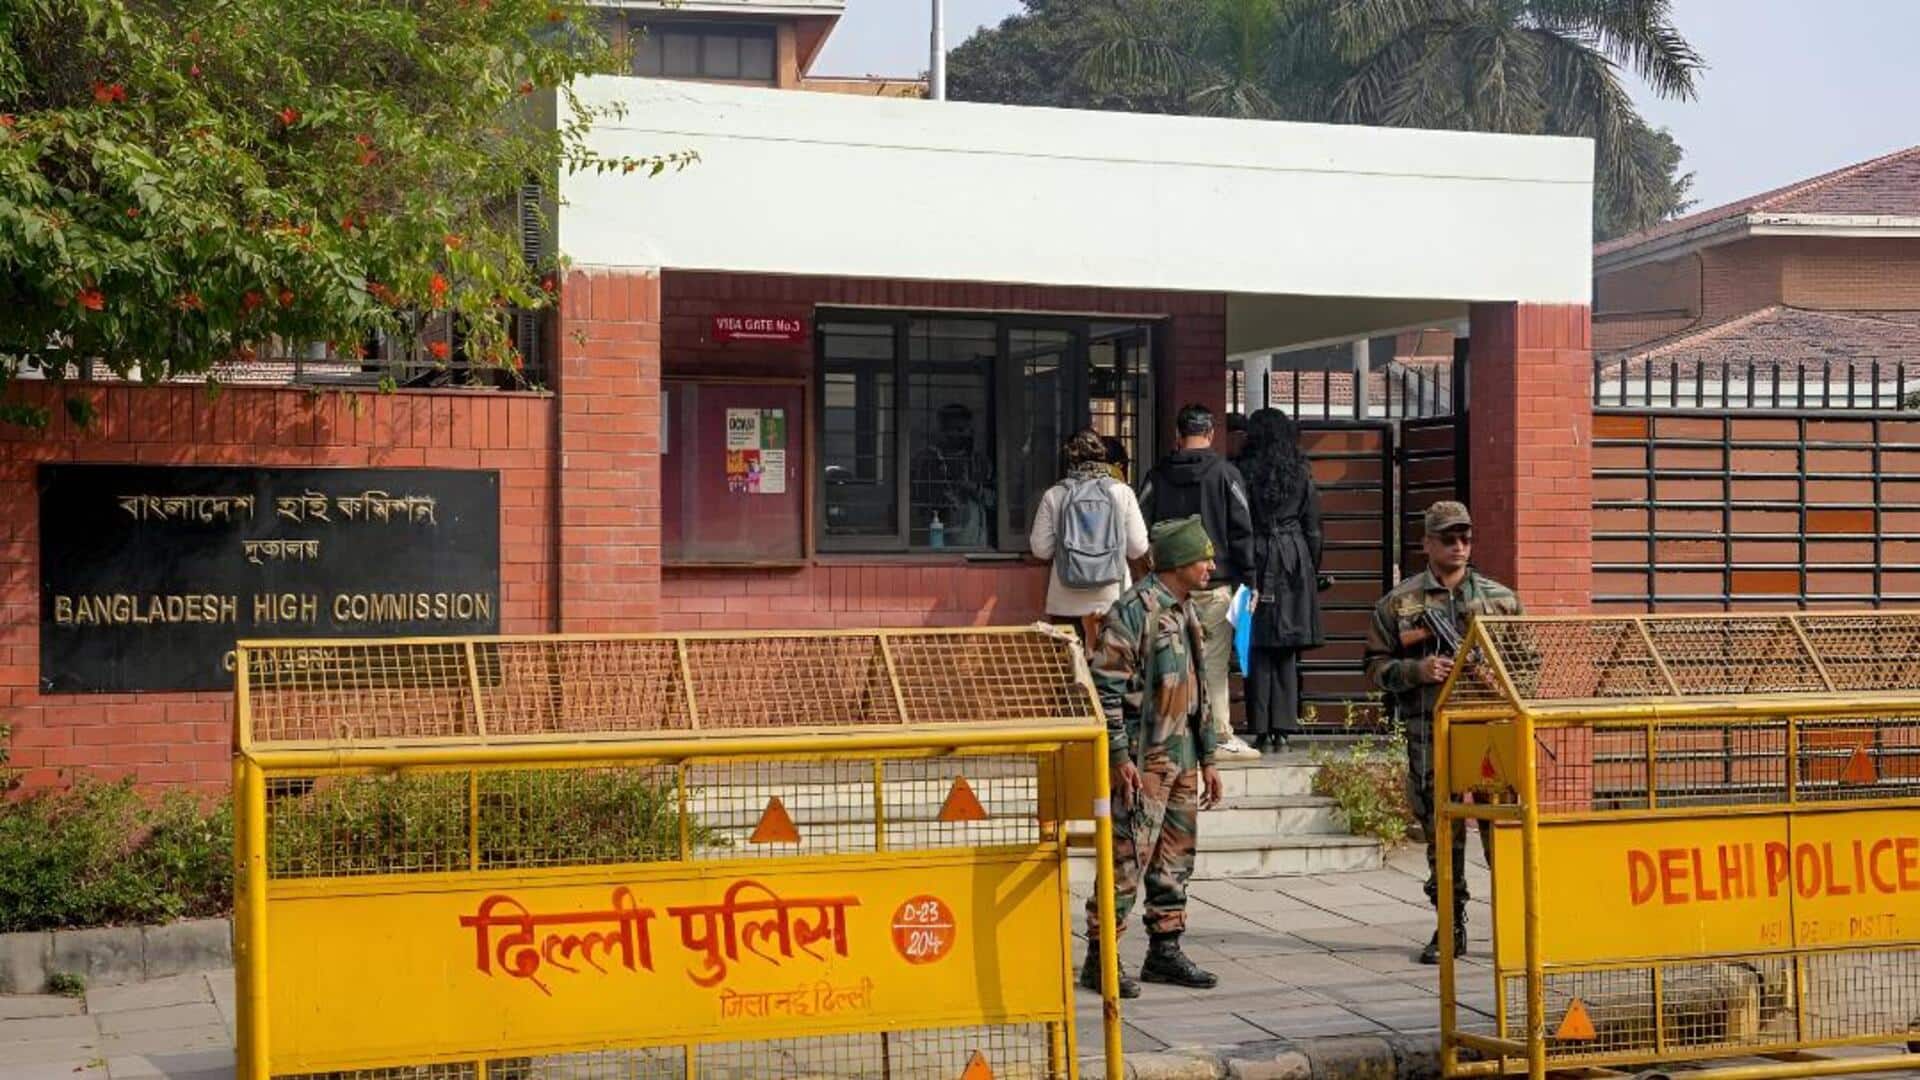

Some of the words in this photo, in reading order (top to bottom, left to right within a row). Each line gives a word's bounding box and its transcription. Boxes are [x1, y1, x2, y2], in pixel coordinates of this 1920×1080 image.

[744, 319, 774, 331] GATE
[116, 494, 255, 522] বাংলাদেশ
[275, 488, 334, 523] হাই
[54, 594, 237, 625] BANGLADESH
[253, 593, 318, 624] HIGH
[333, 591, 491, 622] COMMISSION
[1626, 842, 1757, 906] DELHI
[1764, 837, 1920, 898] POLICE
[903, 901, 940, 923] D-23
[459, 885, 657, 997] दिल्ली
[666, 879, 862, 988] पुलिस
[906, 929, 945, 957] 204
[719, 987, 770, 1018] जिला
[813, 976, 875, 1014] दिल्ली
